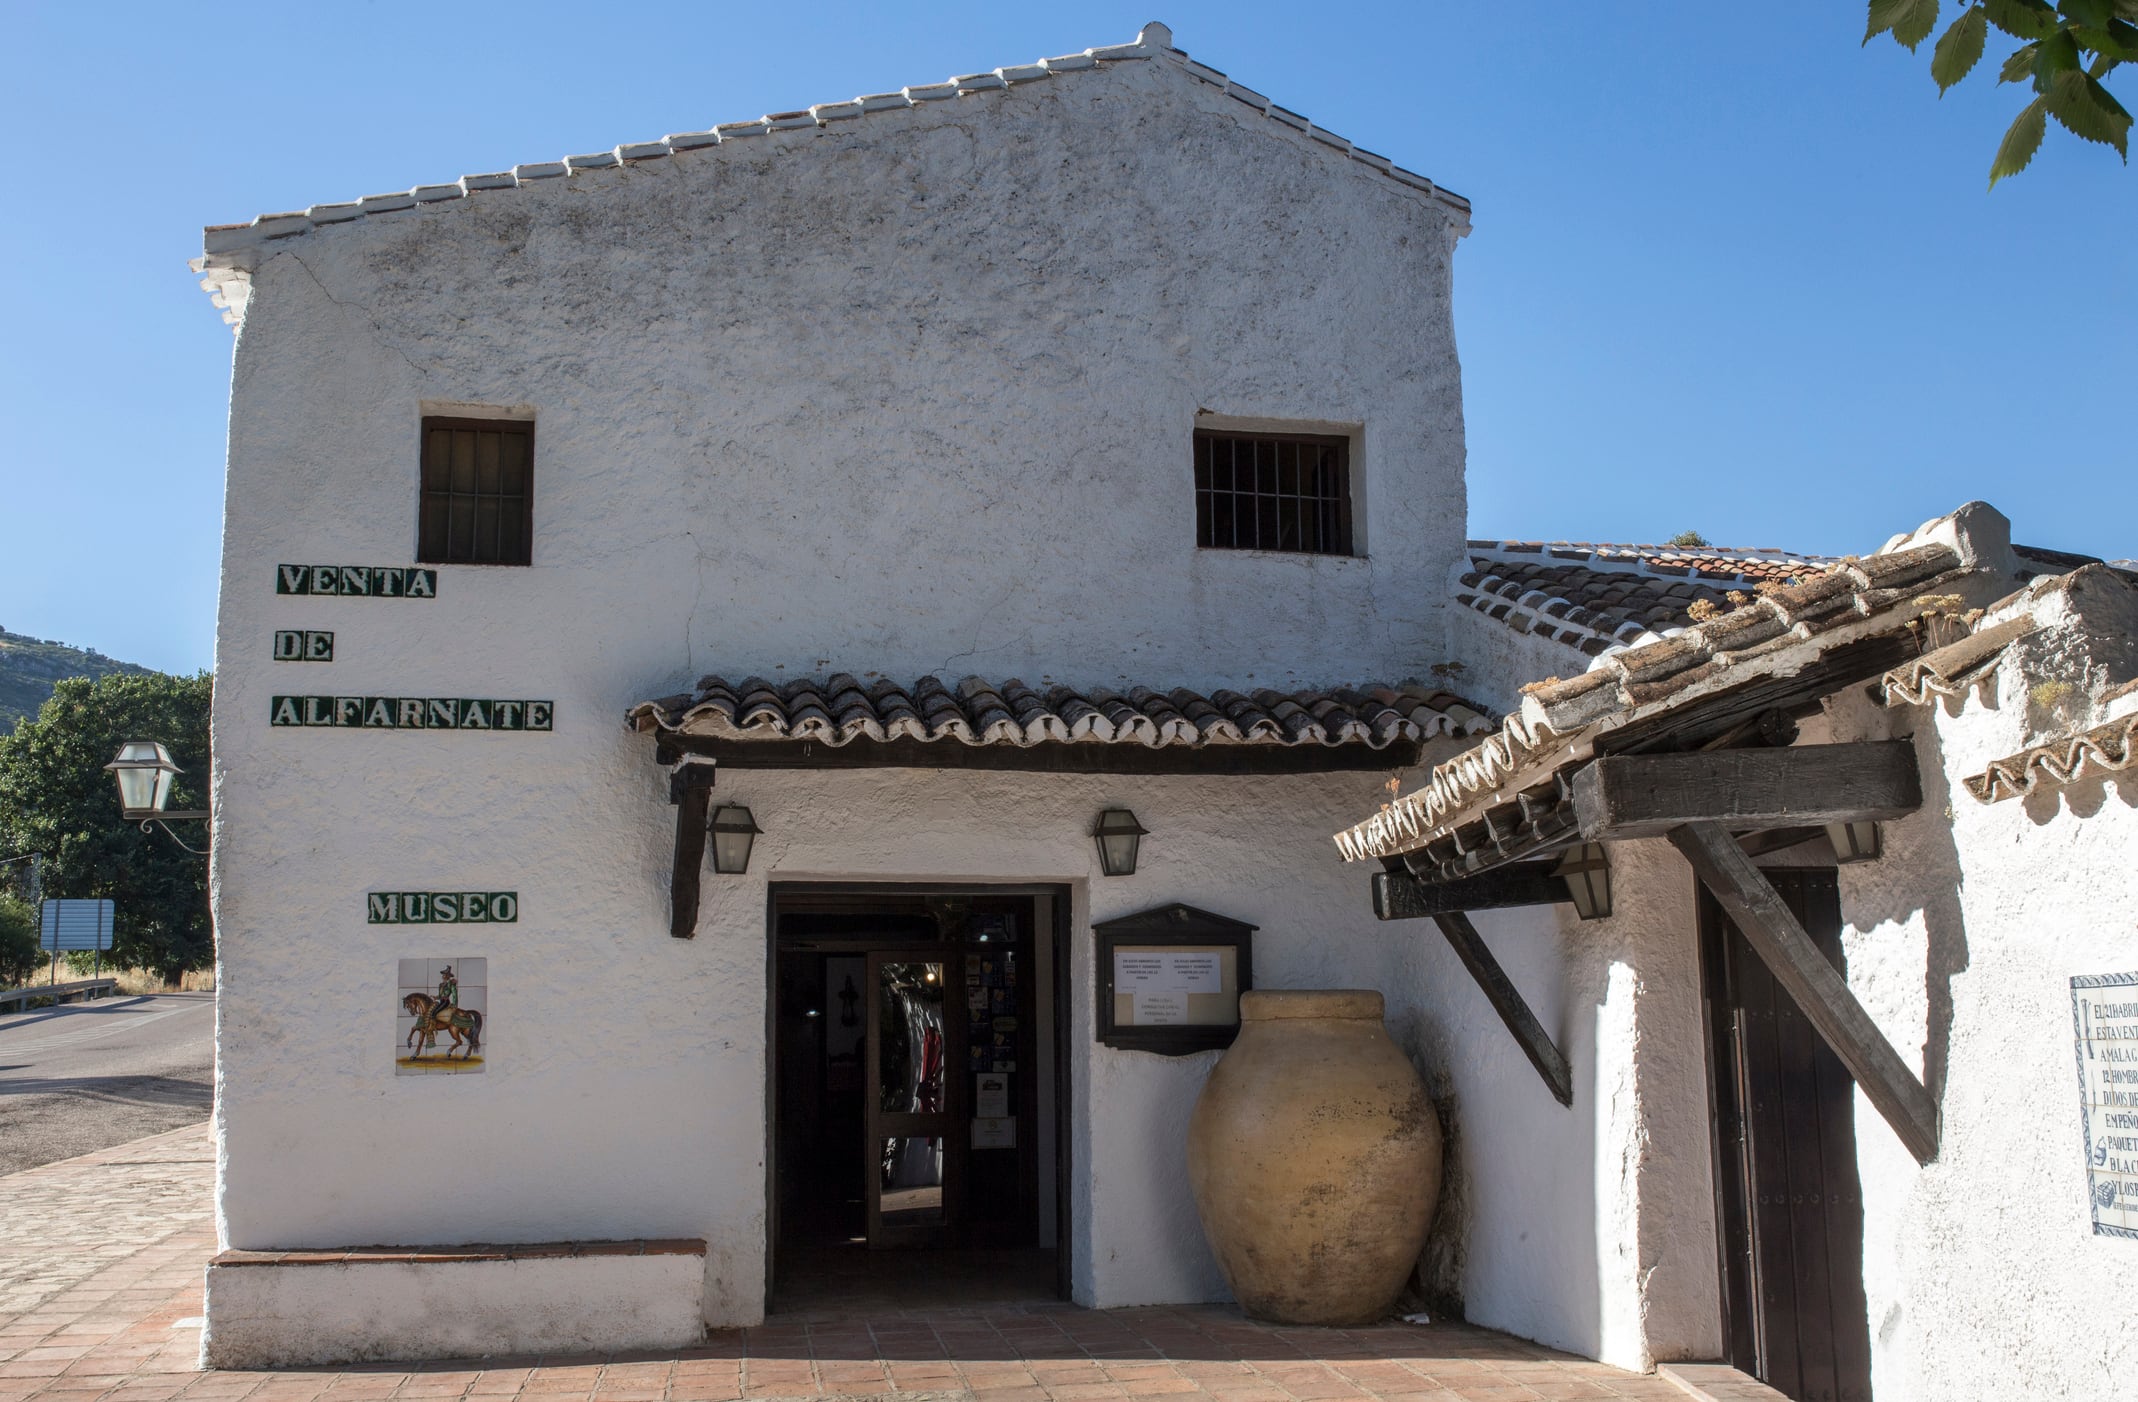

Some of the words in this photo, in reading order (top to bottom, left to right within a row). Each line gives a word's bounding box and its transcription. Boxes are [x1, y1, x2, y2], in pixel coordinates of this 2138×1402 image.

[278, 565, 435, 598] VENTA
[275, 631, 332, 660] DE
[272, 698, 552, 729] ALFARNATE
[369, 893, 517, 922] MUSEO
[2096, 1026, 2116, 1041] ESTA
[2110, 1157, 2138, 1173] BLAC
